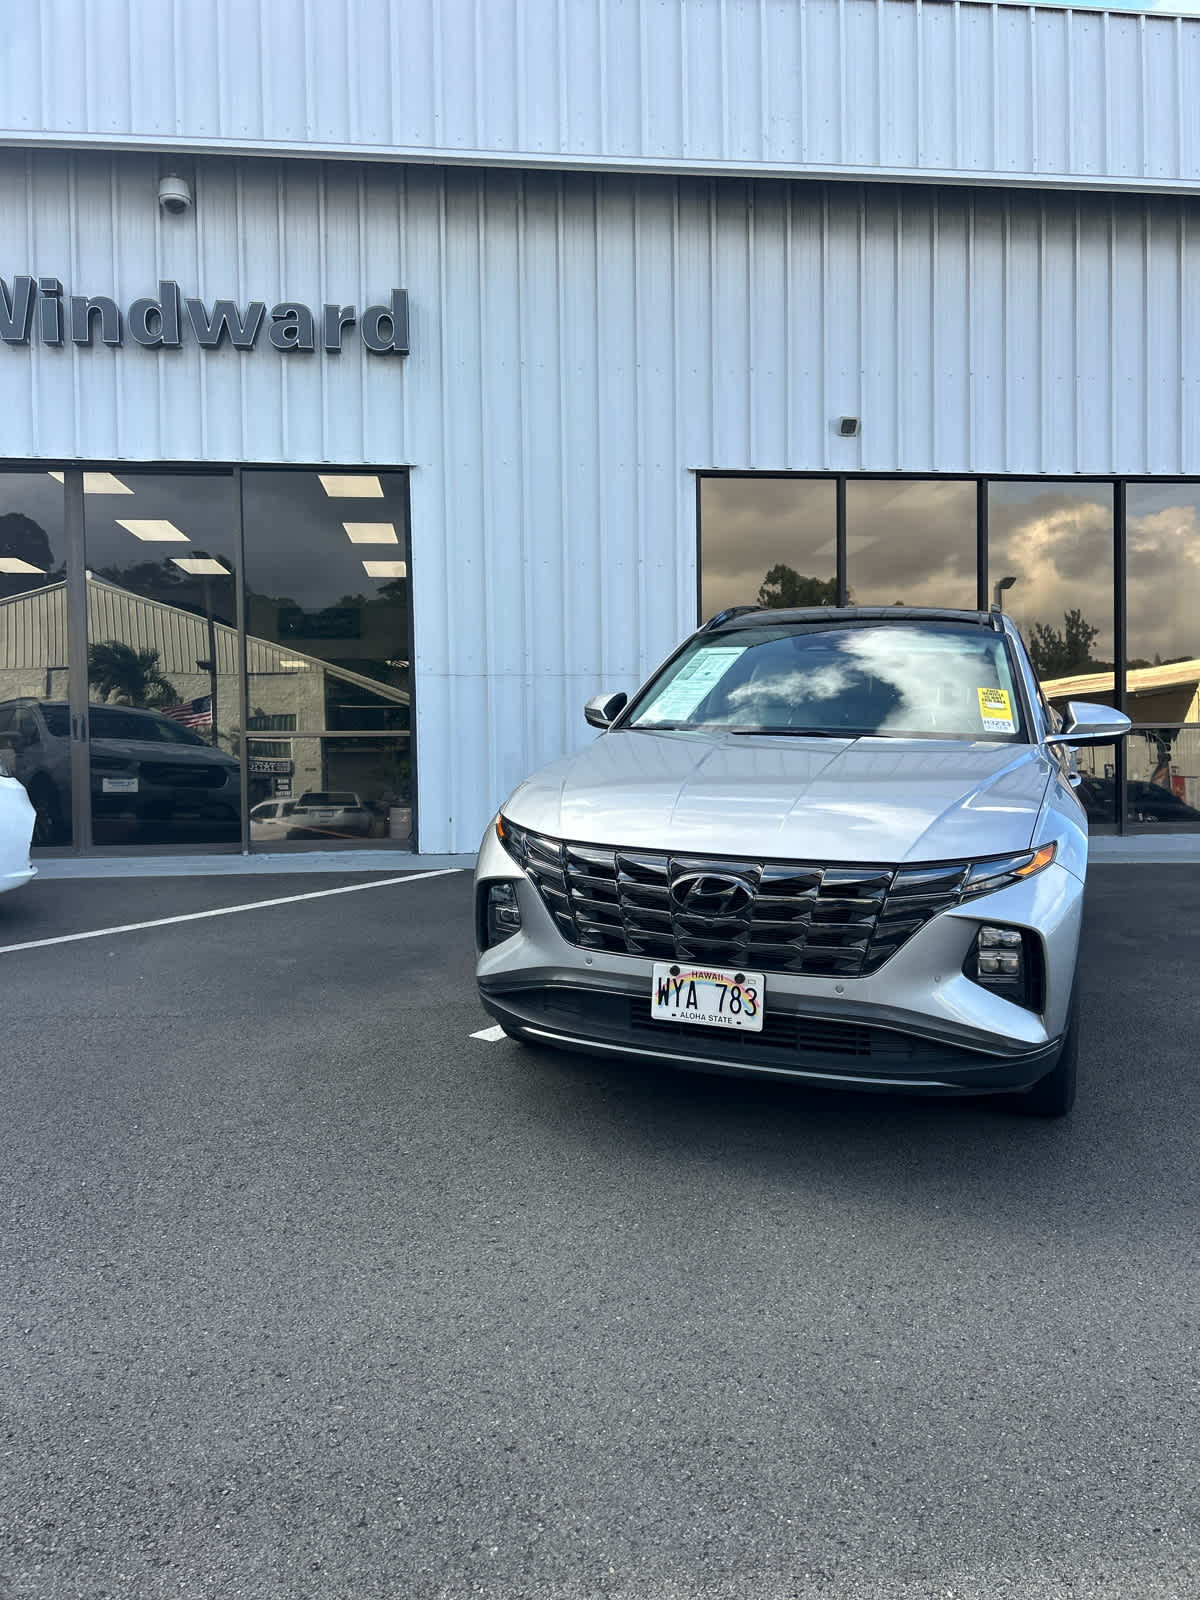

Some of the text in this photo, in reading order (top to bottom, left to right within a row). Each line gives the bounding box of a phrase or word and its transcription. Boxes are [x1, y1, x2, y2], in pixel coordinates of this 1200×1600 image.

[691, 971, 724, 982] HAWAII
[658, 977, 758, 1017] WYA 783
[679, 1011, 733, 1024] ALOHA STATE
